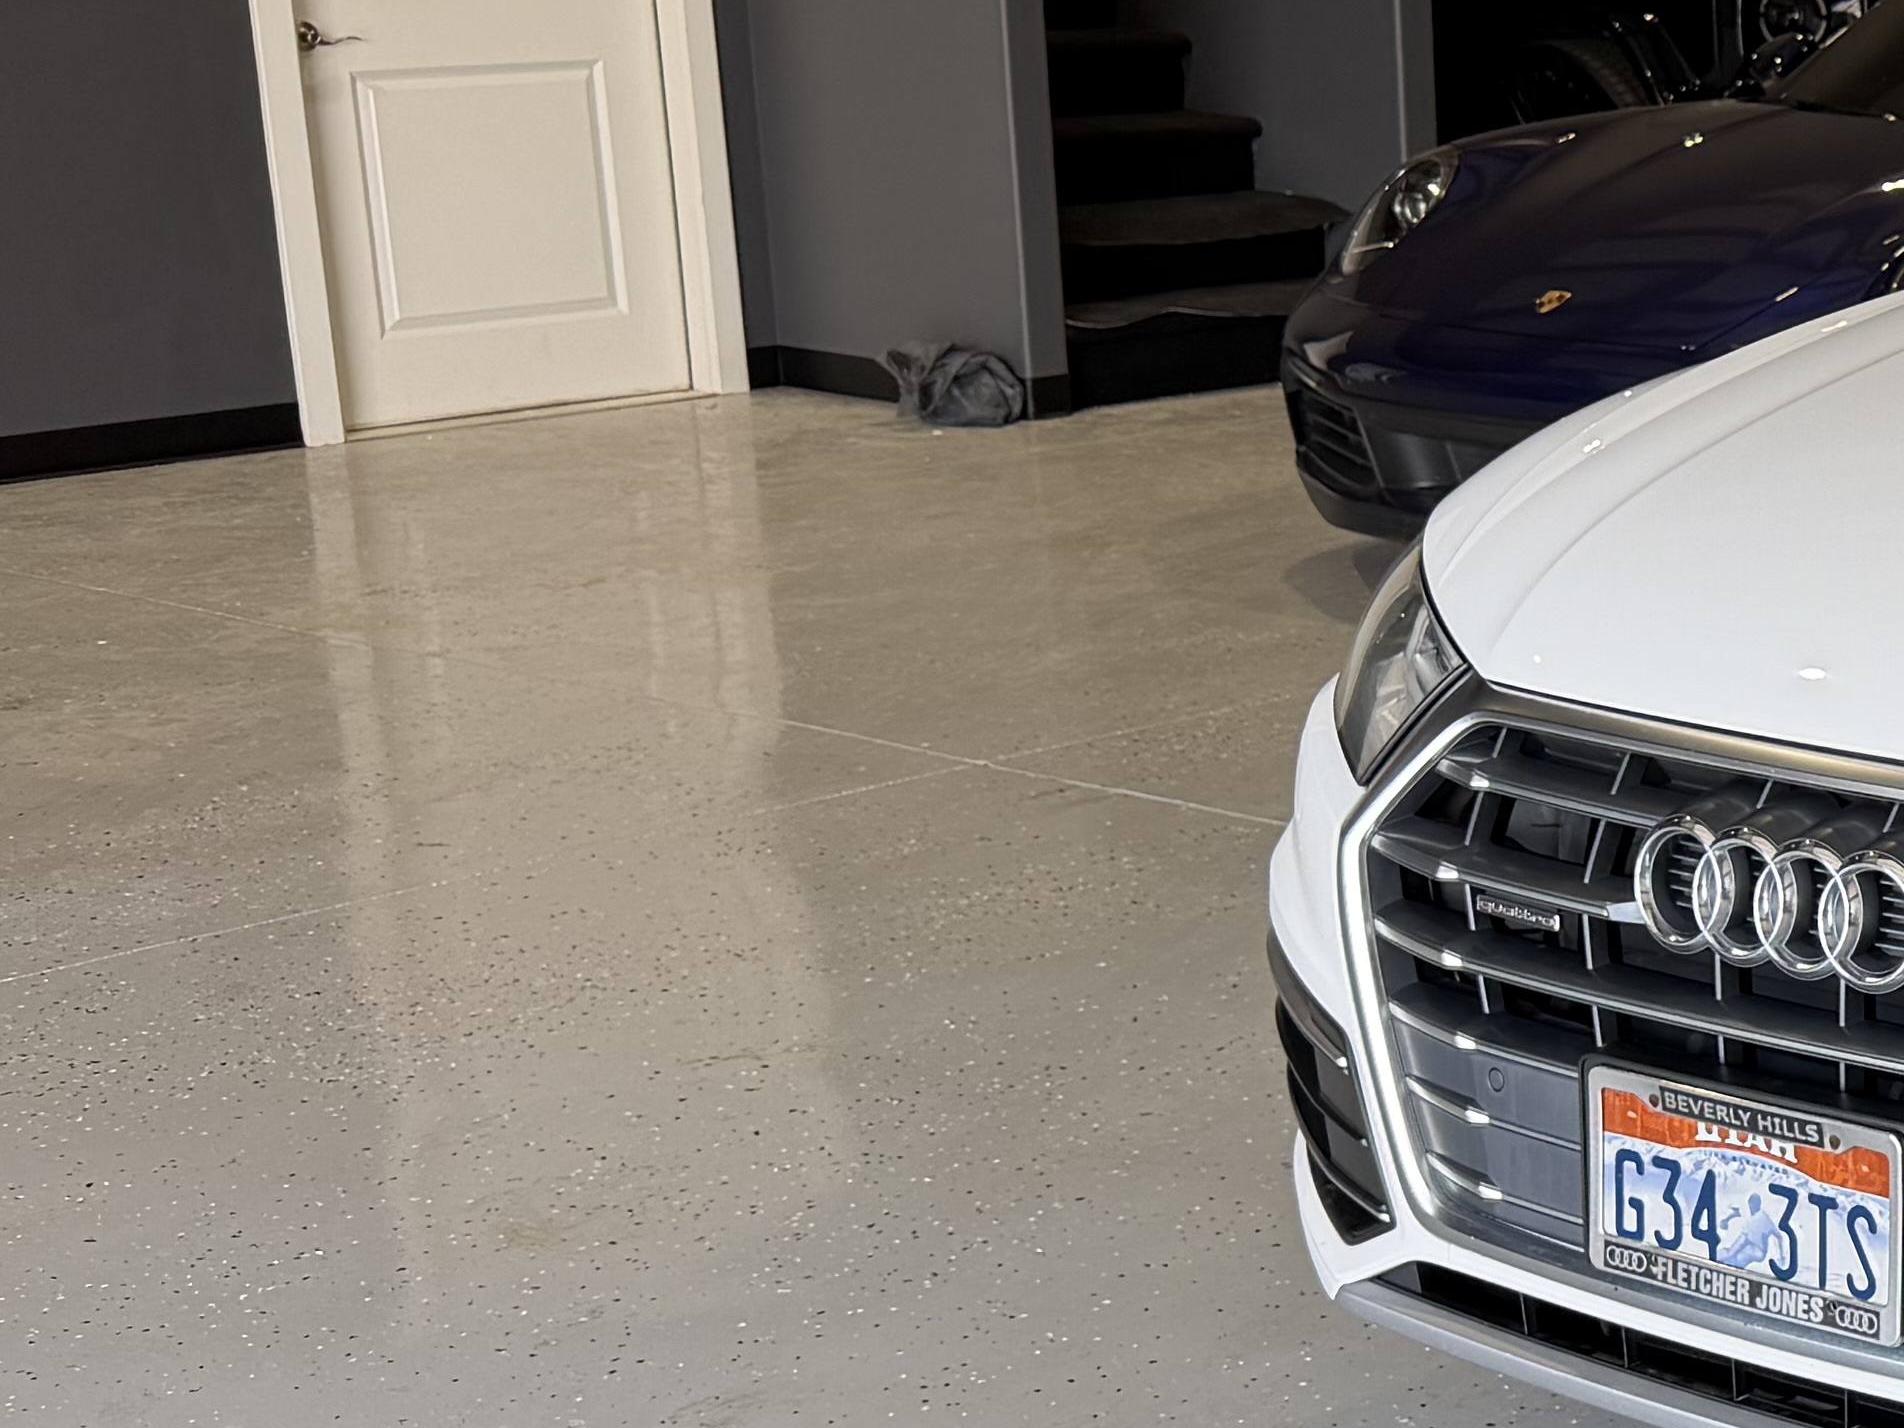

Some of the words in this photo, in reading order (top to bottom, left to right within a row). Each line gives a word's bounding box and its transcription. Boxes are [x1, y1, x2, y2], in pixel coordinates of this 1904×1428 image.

[1480, 900, 1555, 927] quattro
[1664, 1091, 1752, 1127] BEVERLY
[1757, 1113, 1820, 1143] HILLS
[1655, 1255, 1750, 1305] FLETCHER
[1756, 1285, 1824, 1322] JONES
